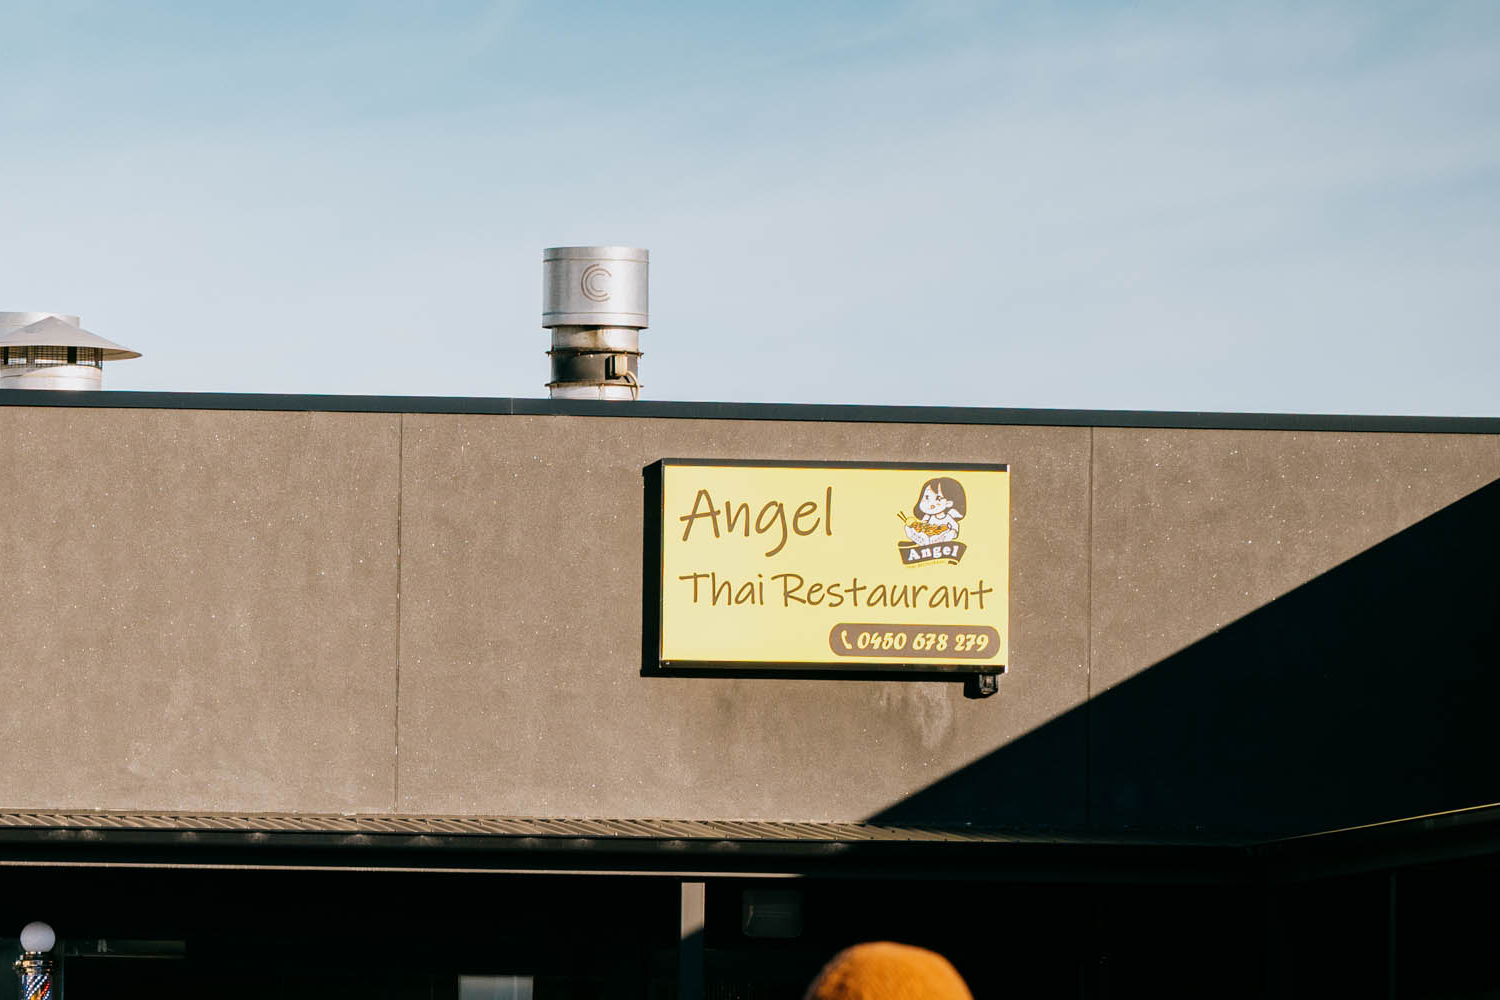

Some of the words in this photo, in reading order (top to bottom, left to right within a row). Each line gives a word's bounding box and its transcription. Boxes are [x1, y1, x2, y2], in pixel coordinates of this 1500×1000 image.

[679, 486, 833, 557] Angel
[908, 545, 959, 561] Angel
[679, 572, 765, 606] Thai
[771, 574, 993, 610] Restaurant
[857, 632, 907, 650] 0450
[912, 633, 949, 652] 678
[954, 634, 989, 652] 279
